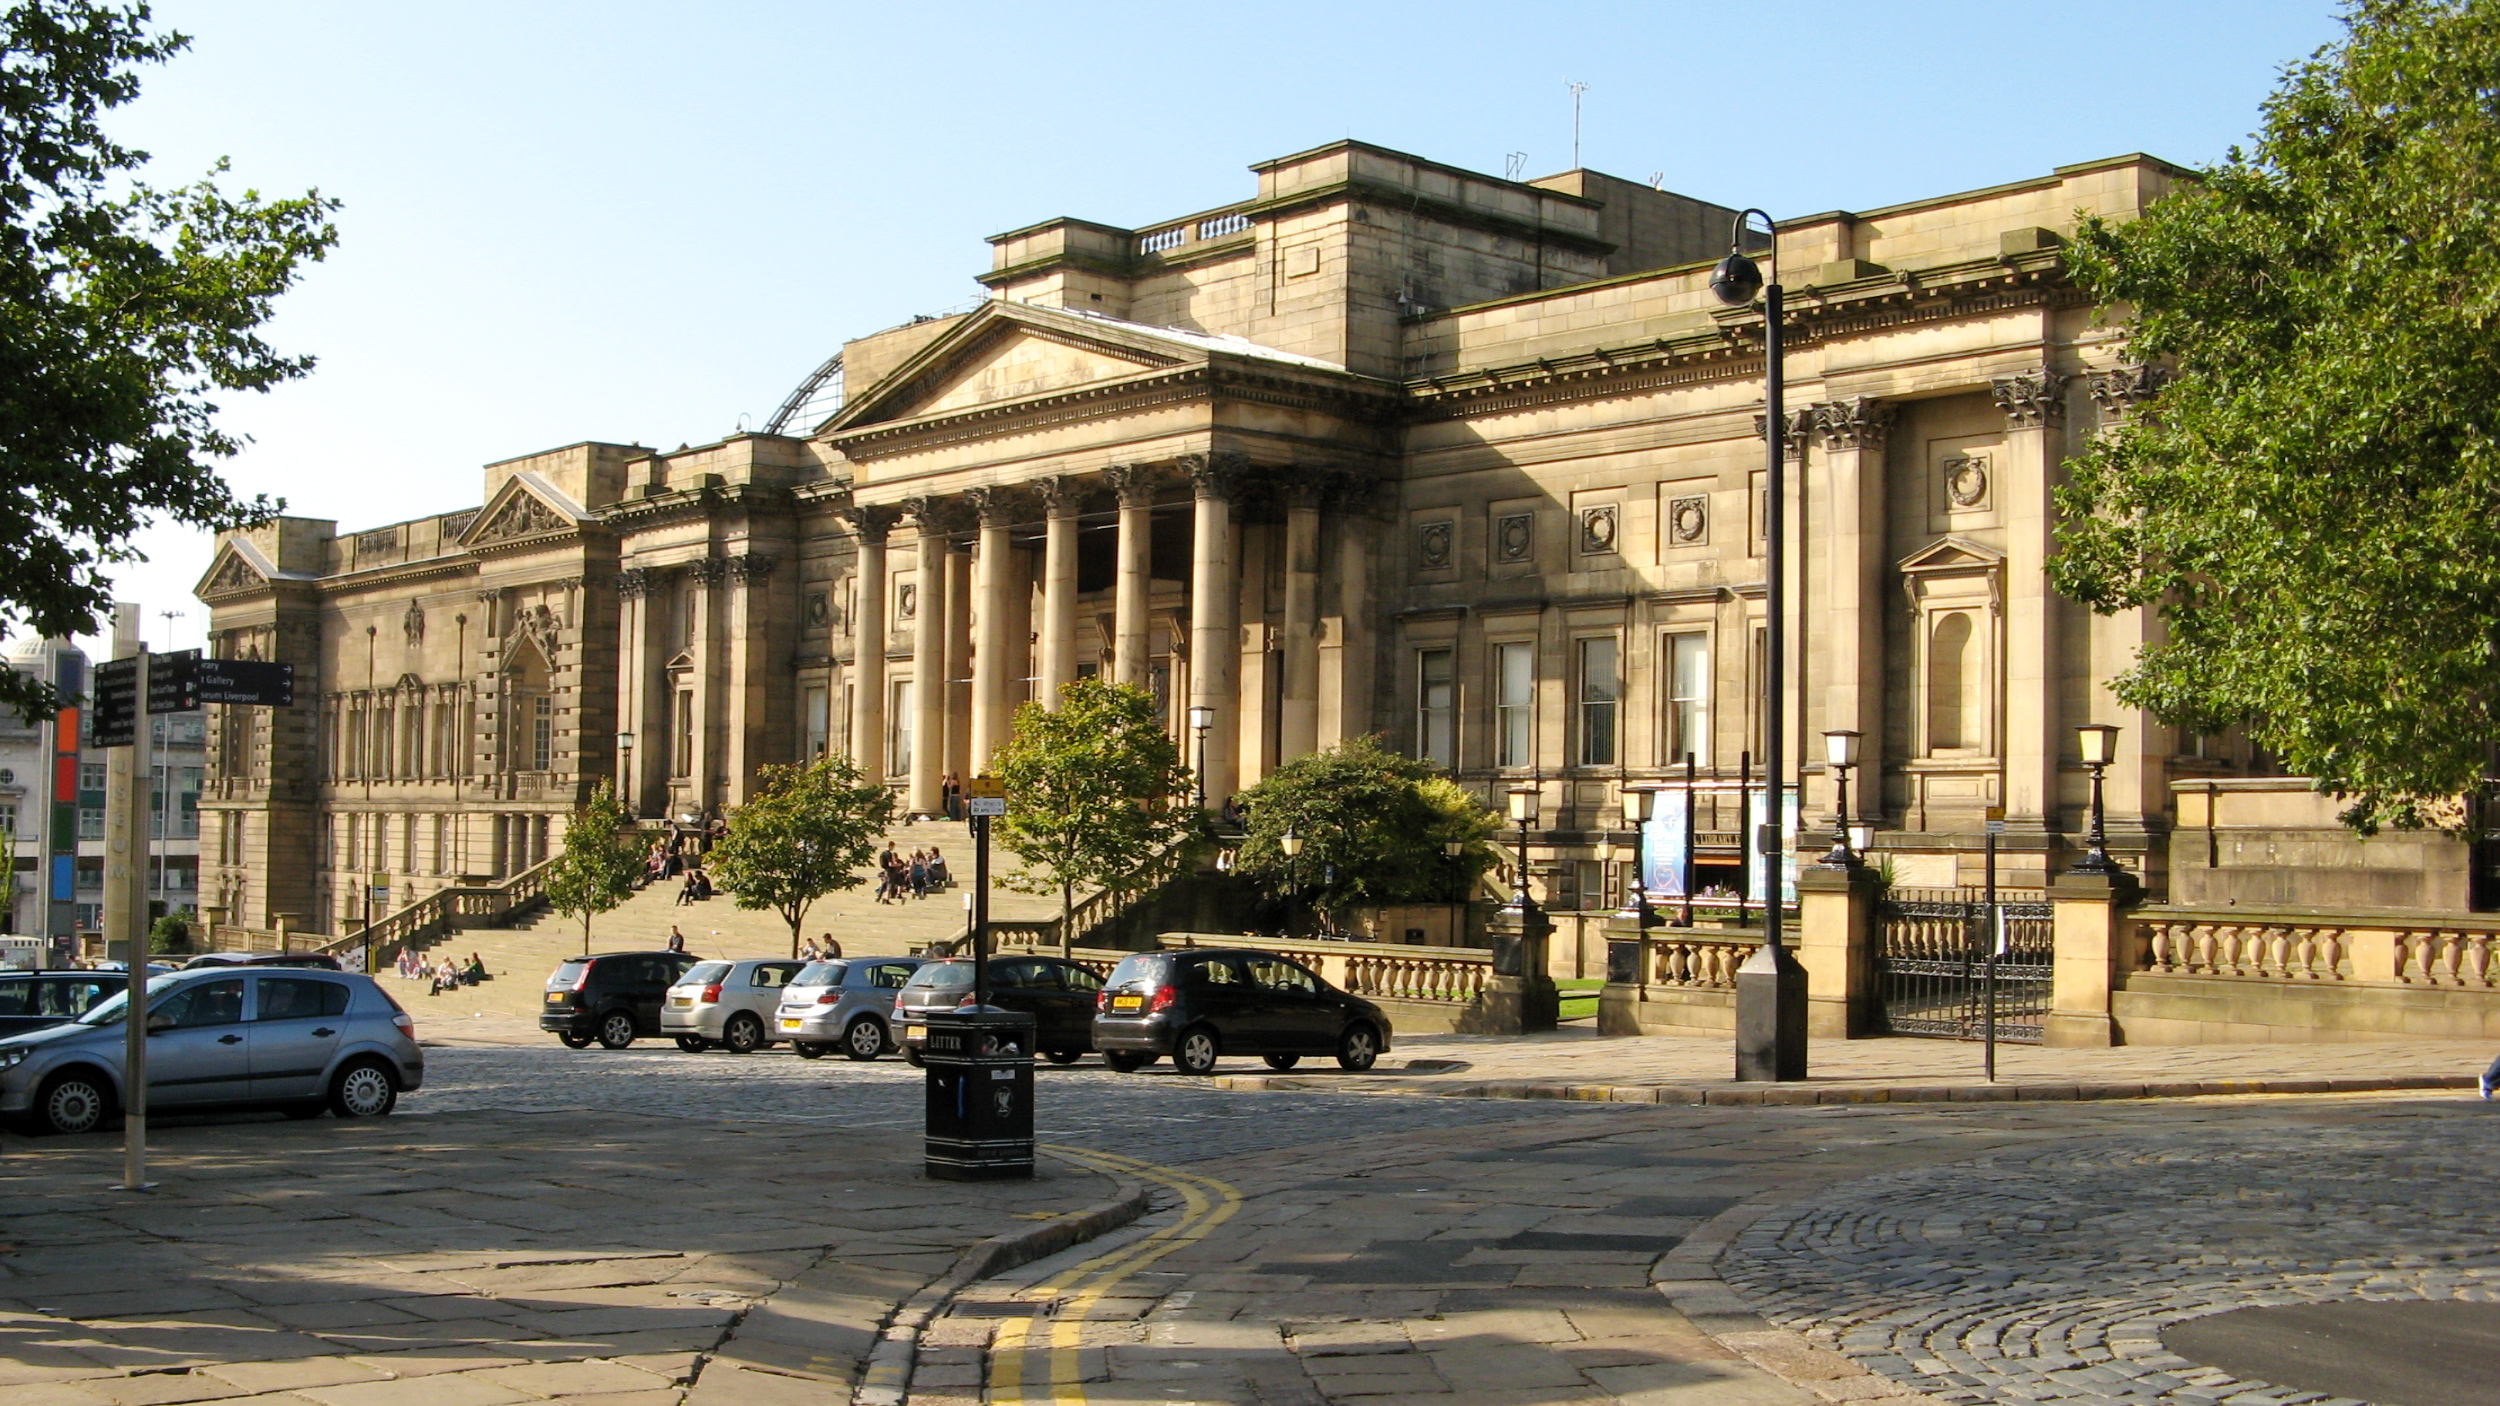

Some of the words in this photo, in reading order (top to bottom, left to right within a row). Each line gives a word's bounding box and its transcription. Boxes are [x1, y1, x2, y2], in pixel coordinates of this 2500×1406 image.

[201, 662, 219, 671] rary
[206, 675, 235, 687] Gallery
[201, 692, 222, 700] seum
[224, 691, 259, 702] Liverpool
[112, 759, 126, 880] USEUM
[1701, 834, 1733, 845] LIBRARY
[930, 1035, 961, 1050] LITTER
